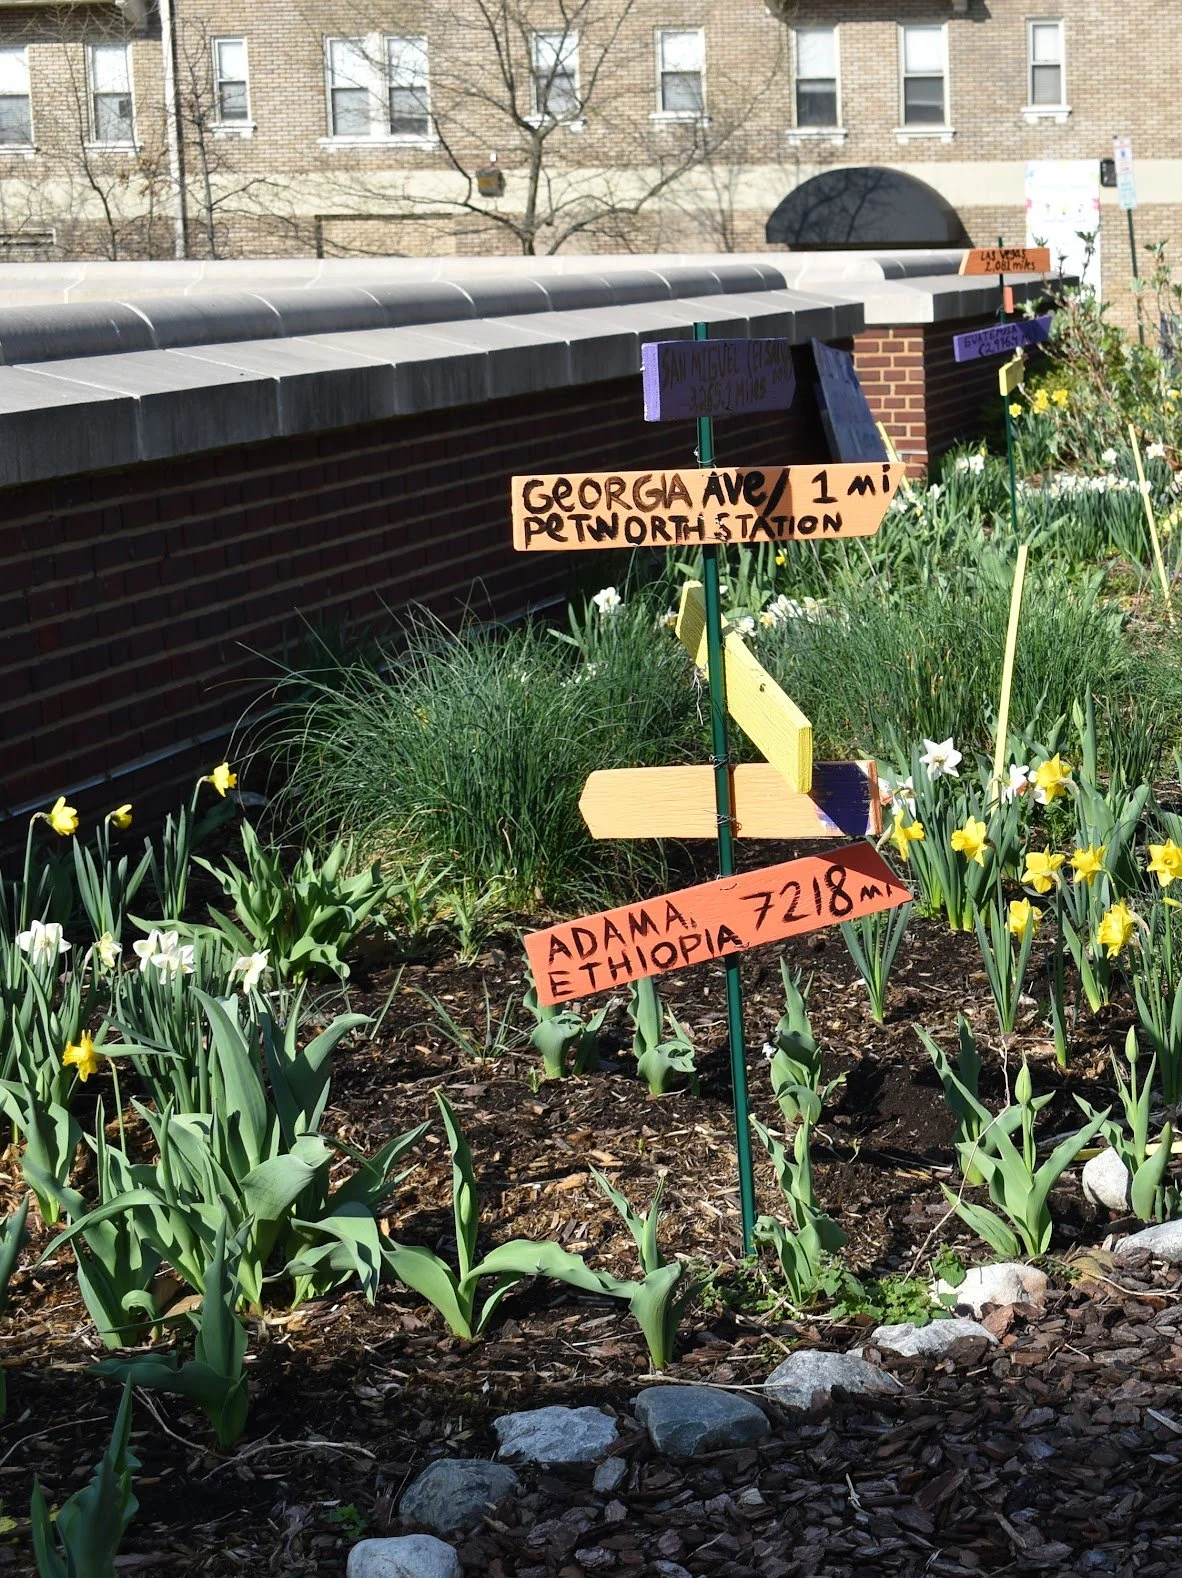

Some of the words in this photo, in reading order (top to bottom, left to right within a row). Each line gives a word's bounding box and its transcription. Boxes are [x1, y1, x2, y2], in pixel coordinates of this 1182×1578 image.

[812, 470, 838, 503] 1
[714, 511, 843, 543] STATION
[740, 864, 854, 931] 7218
[548, 924, 743, 998] ETHIOPIA
